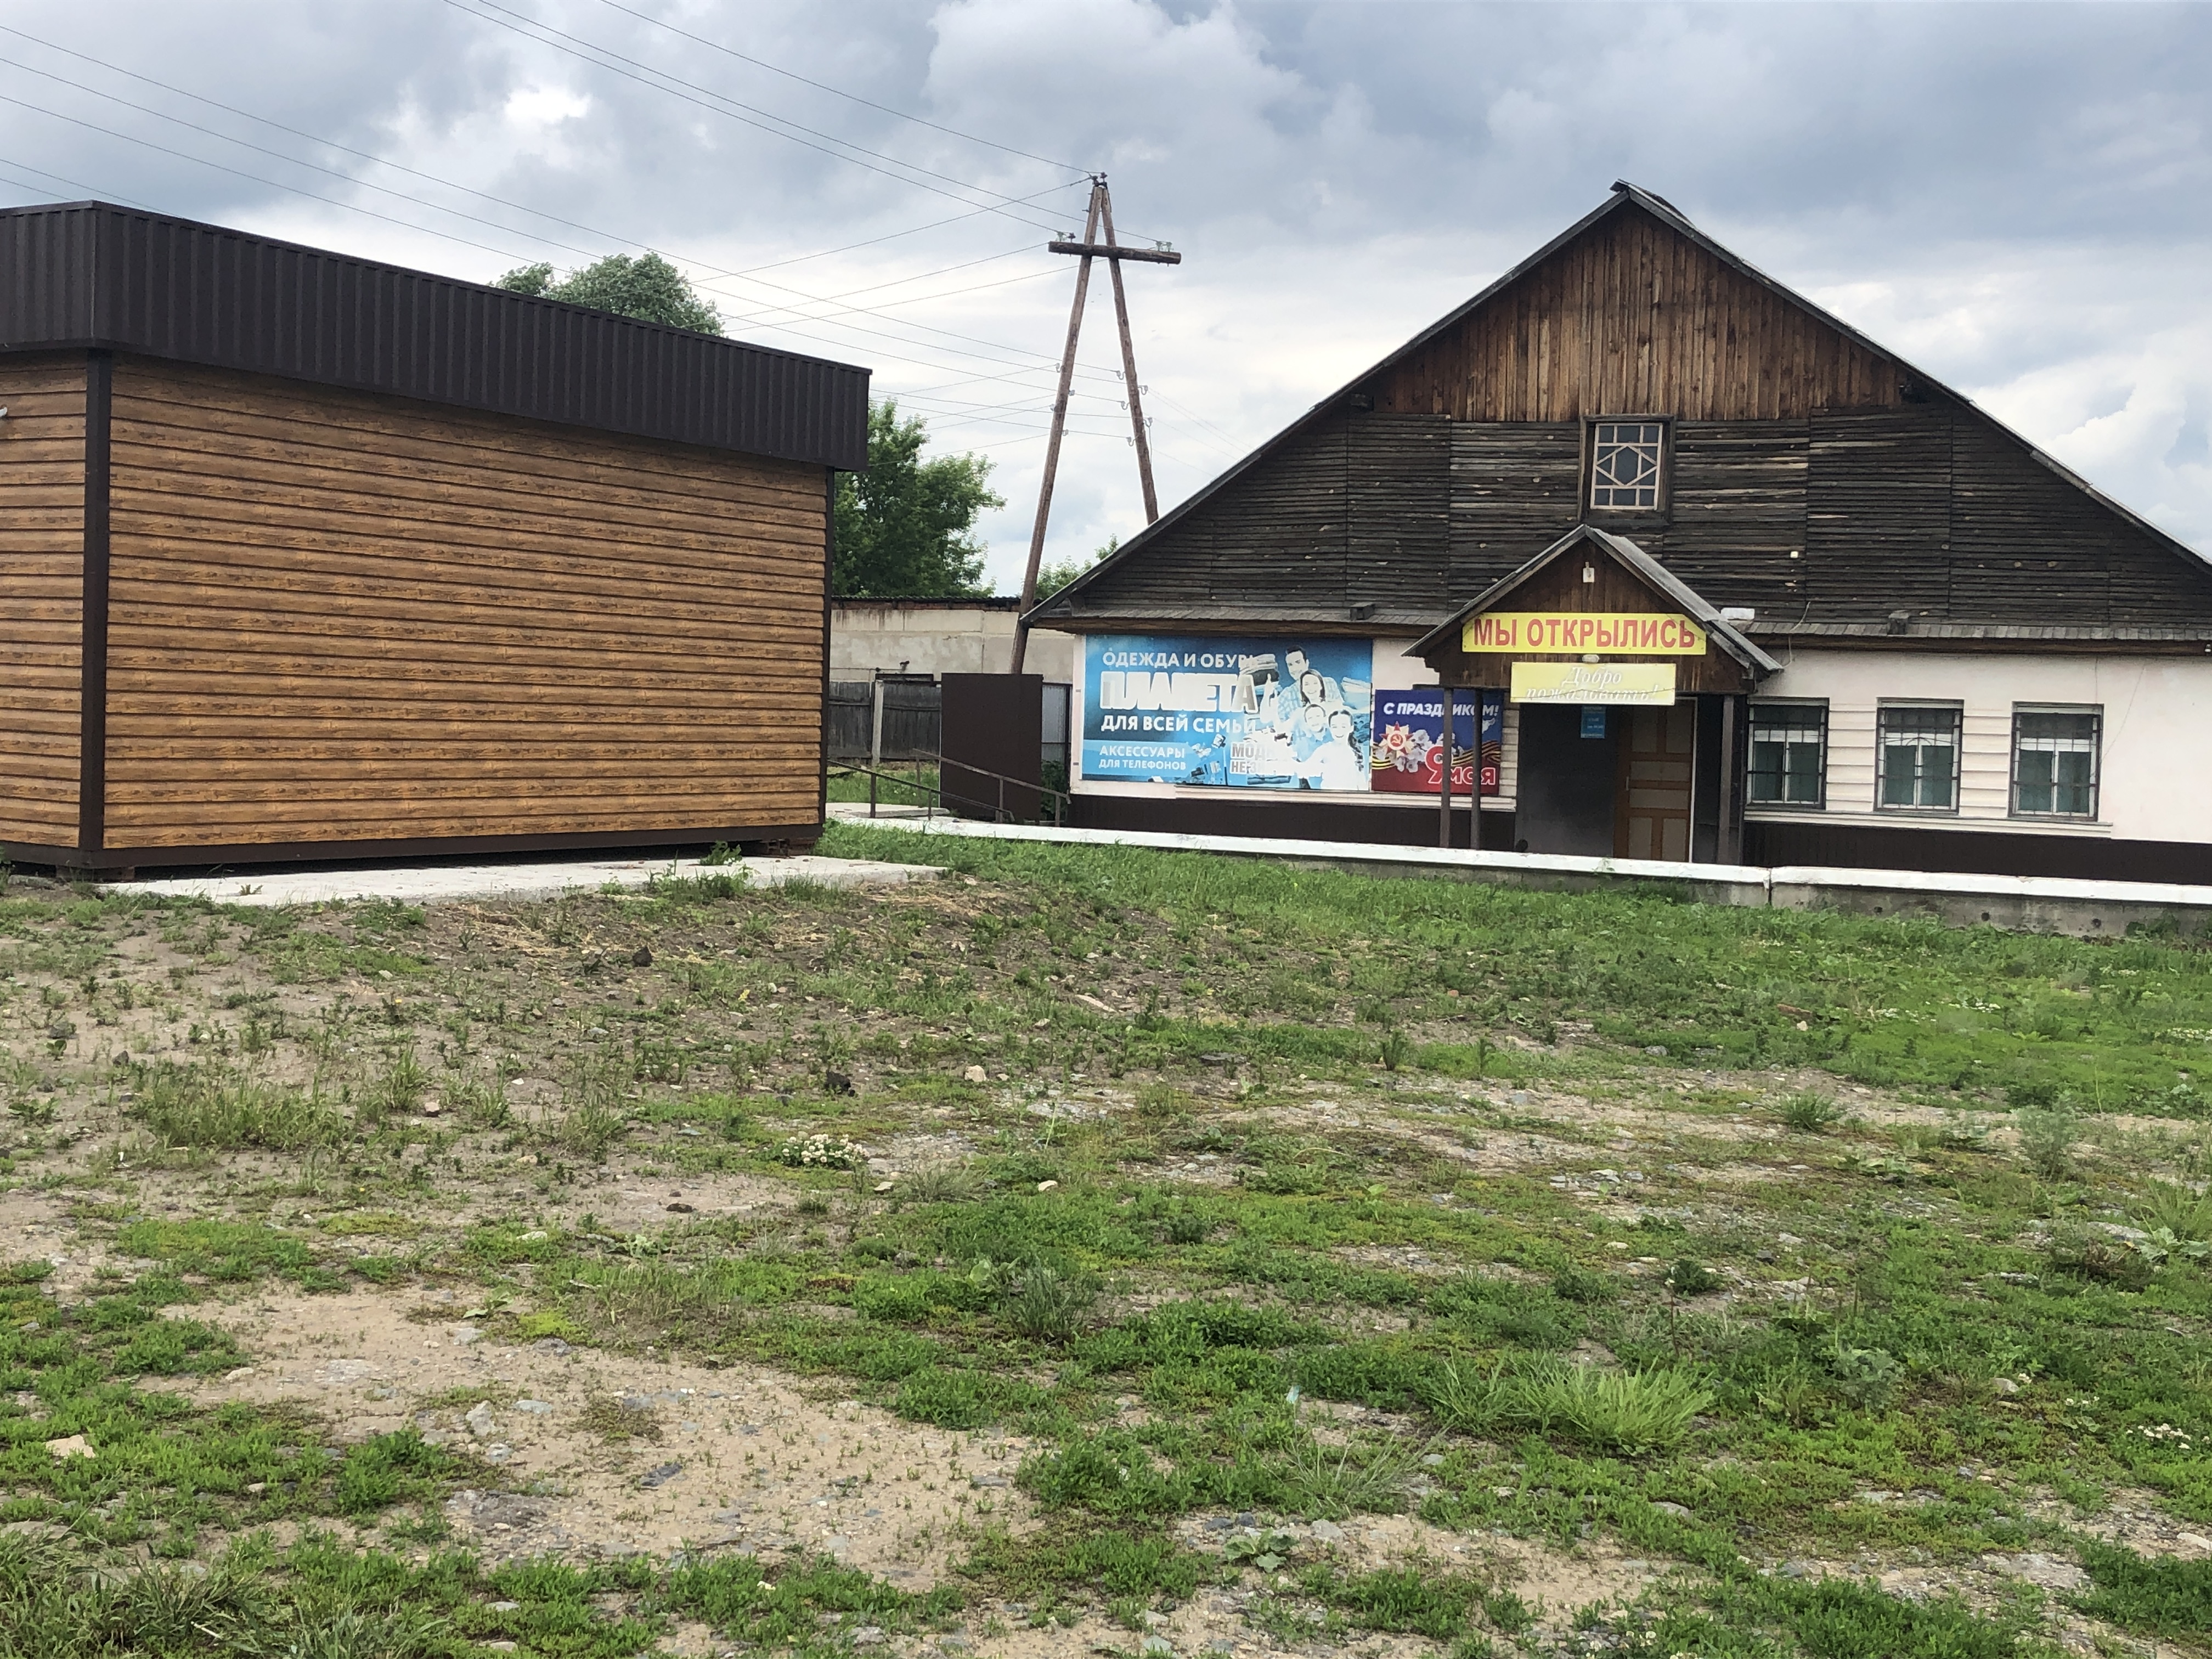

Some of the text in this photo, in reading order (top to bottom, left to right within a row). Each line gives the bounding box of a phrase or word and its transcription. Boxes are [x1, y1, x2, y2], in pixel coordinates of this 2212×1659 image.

[1474, 618, 1695, 648] МЫ ОТКРЫЛИСЬ
[1102, 652, 1180, 668] ОДЕЖДА
[1184, 653, 1196, 667] И
[1562, 667, 1622, 689] Добро
[1527, 684, 1659, 702] пожаловать!
[1383, 702, 1499, 718] С ПРАЗДИКМ!
[1101, 714, 1256, 733] ДЛЯ ВСЕЙ СЕМЬИ
[1099, 745, 1185, 758] АКСЕССУАРЫ
[1098, 759, 1187, 771] ДЛЯ ТЕЛЕФОНОВ
